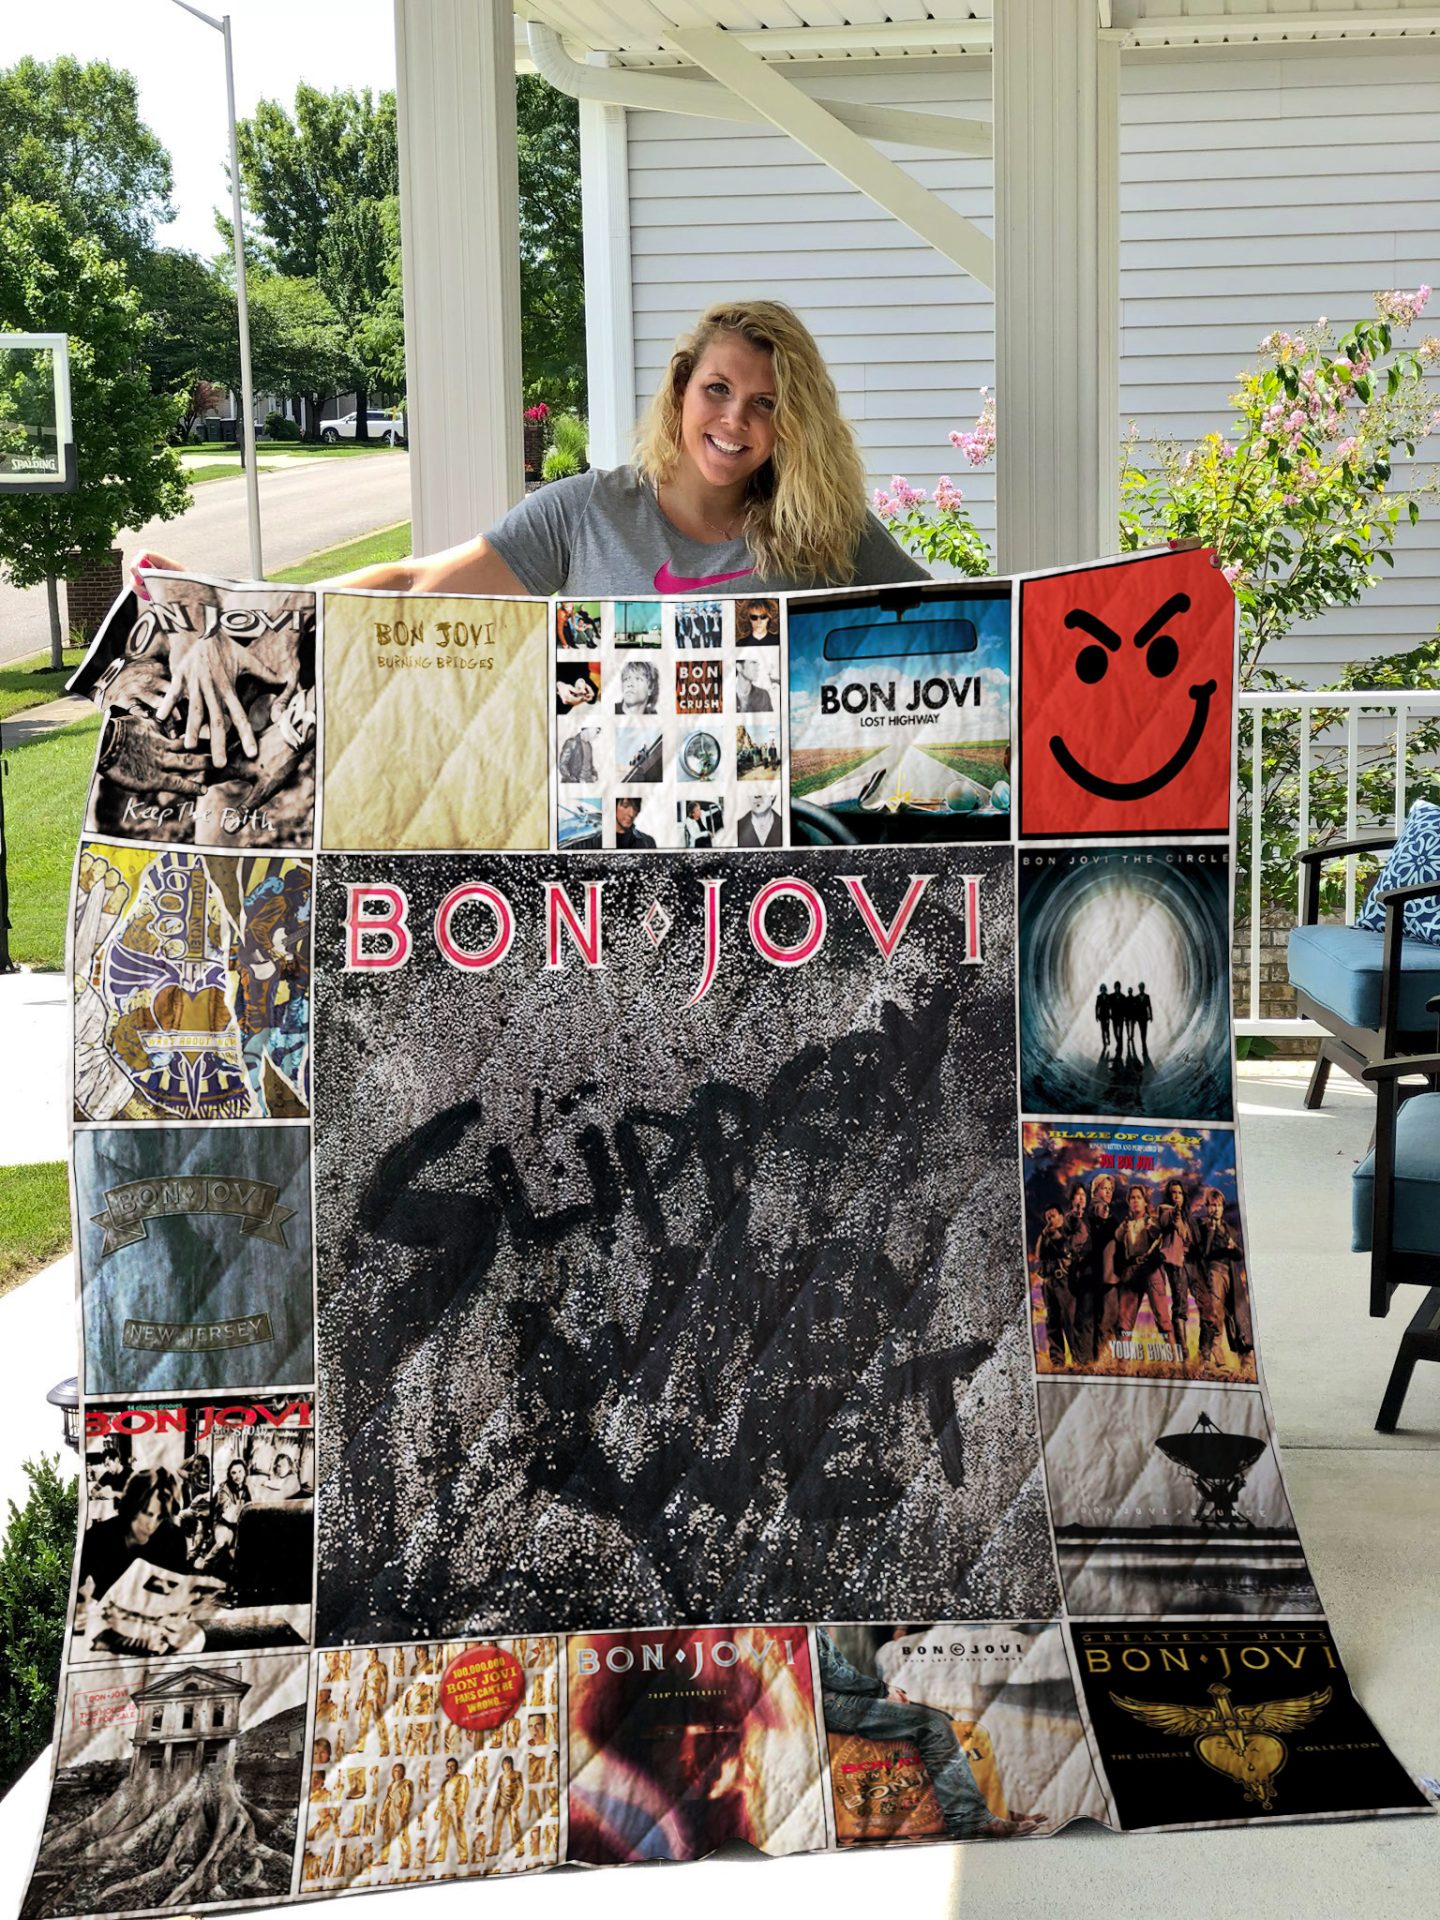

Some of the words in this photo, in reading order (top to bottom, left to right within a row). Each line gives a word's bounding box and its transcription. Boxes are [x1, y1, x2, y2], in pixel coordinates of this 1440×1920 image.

[11, 458, 56, 470] SPALDING
[199, 604, 303, 640] JOVI
[374, 620, 424, 647] BON
[434, 621, 495, 648] JOVI
[377, 655, 432, 669] BURNING
[437, 655, 494, 670] BRIDGES
[679, 666, 718, 679] BON
[679, 683, 718, 696] JOVI
[821, 681, 896, 715] BON
[906, 676, 981, 711] JOVI
[679, 699, 719, 709] CRUSH
[860, 716, 884, 728] LOST
[888, 713, 940, 726] HIGHWAY
[122, 797, 174, 827] Keep
[1023, 857, 1056, 866] BON
[1069, 855, 1109, 865] JOVI
[1122, 854, 1153, 864] THE
[1165, 853, 1229, 864] CIRCLE
[341, 881, 607, 974] BON
[683, 874, 987, 1010] JOVI
[1049, 1130, 1111, 1139] BLAZE
[1114, 1132, 1139, 1141] OF
[1141, 1134, 1204, 1145] GLORY
[117, 1180, 181, 1217] BON
[199, 1180, 273, 1211] JOVI
[129, 1323, 174, 1344] NEW
[185, 1318, 263, 1350] JERSEY
[1108, 1340, 1144, 1360] YOUNG
[85, 1407, 189, 1437] BON
[193, 1401, 311, 1441] JOVI
[1082, 1632, 1230, 1642] GREATEST
[1258, 1632, 1329, 1641] HITS
[576, 1643, 666, 1676] BON
[689, 1639, 796, 1680] JOVI
[902, 1645, 944, 1656] BON
[970, 1644, 1023, 1655] JOVI
[1085, 1647, 1191, 1673] BON
[1216, 1646, 1338, 1679] JOVI
[446, 1677, 478, 1695] BON
[481, 1666, 518, 1685] JOVI
[502, 1680, 514, 1692] BE
